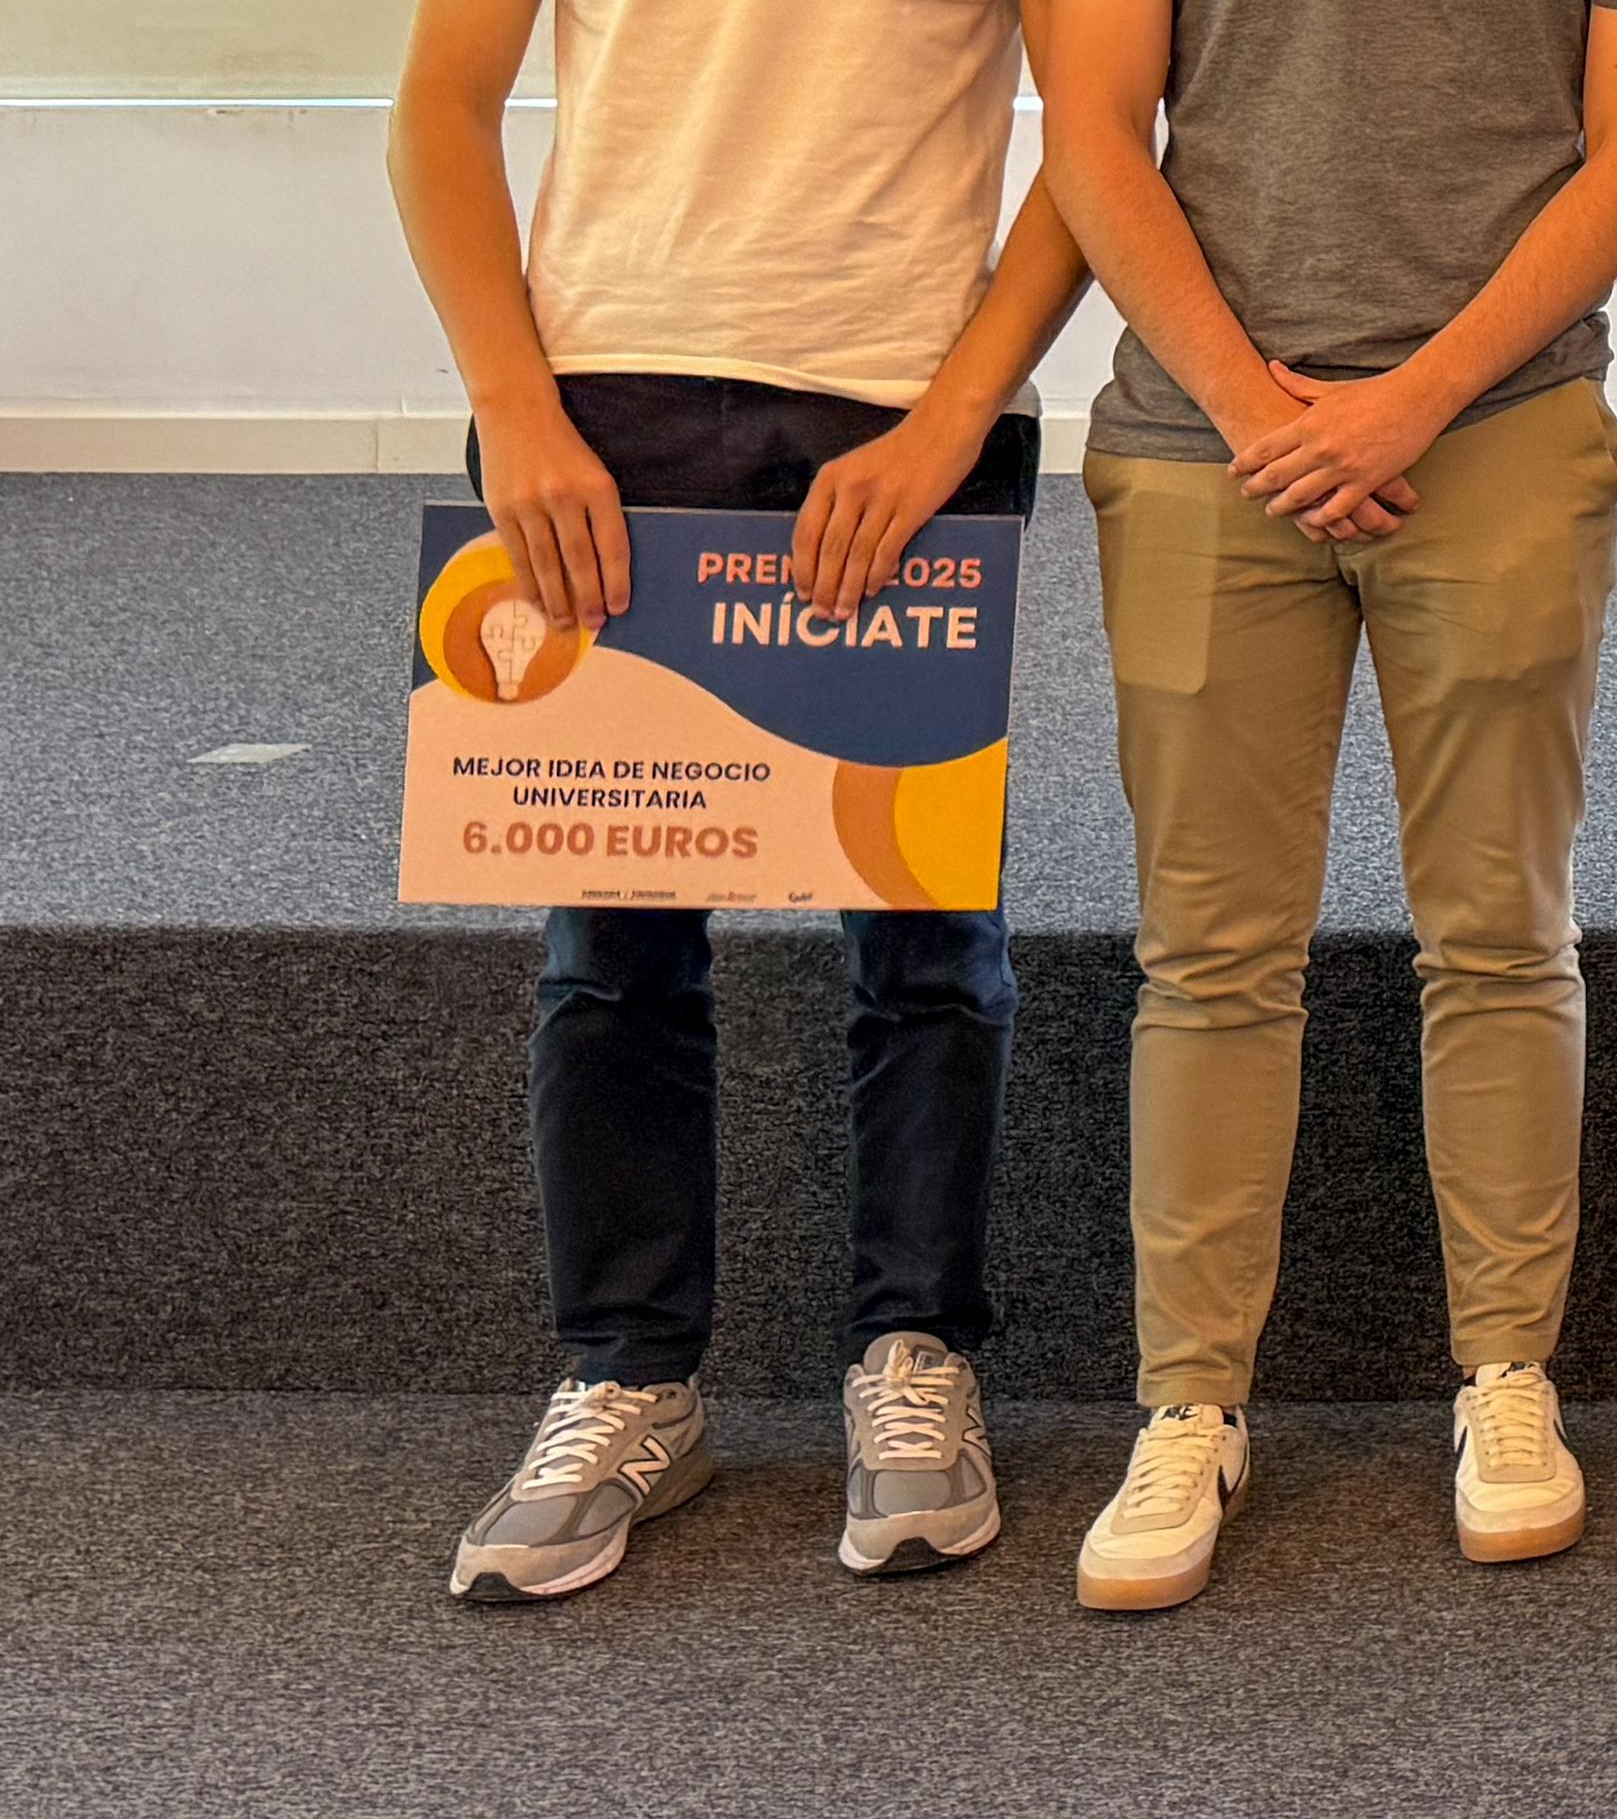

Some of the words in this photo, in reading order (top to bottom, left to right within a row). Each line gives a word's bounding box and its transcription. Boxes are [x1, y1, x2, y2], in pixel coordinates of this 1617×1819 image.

[883, 557, 982, 589] 025
[712, 591, 979, 649] INÍCIATE
[453, 756, 541, 778] MEJOR
[548, 759, 606, 780] IDEA
[613, 760, 645, 780] DE
[651, 761, 771, 782] NEGOCIO
[513, 786, 708, 810] UNIVERSITARIA
[463, 821, 595, 857] 6.000
[606, 824, 759, 860] EUROS
